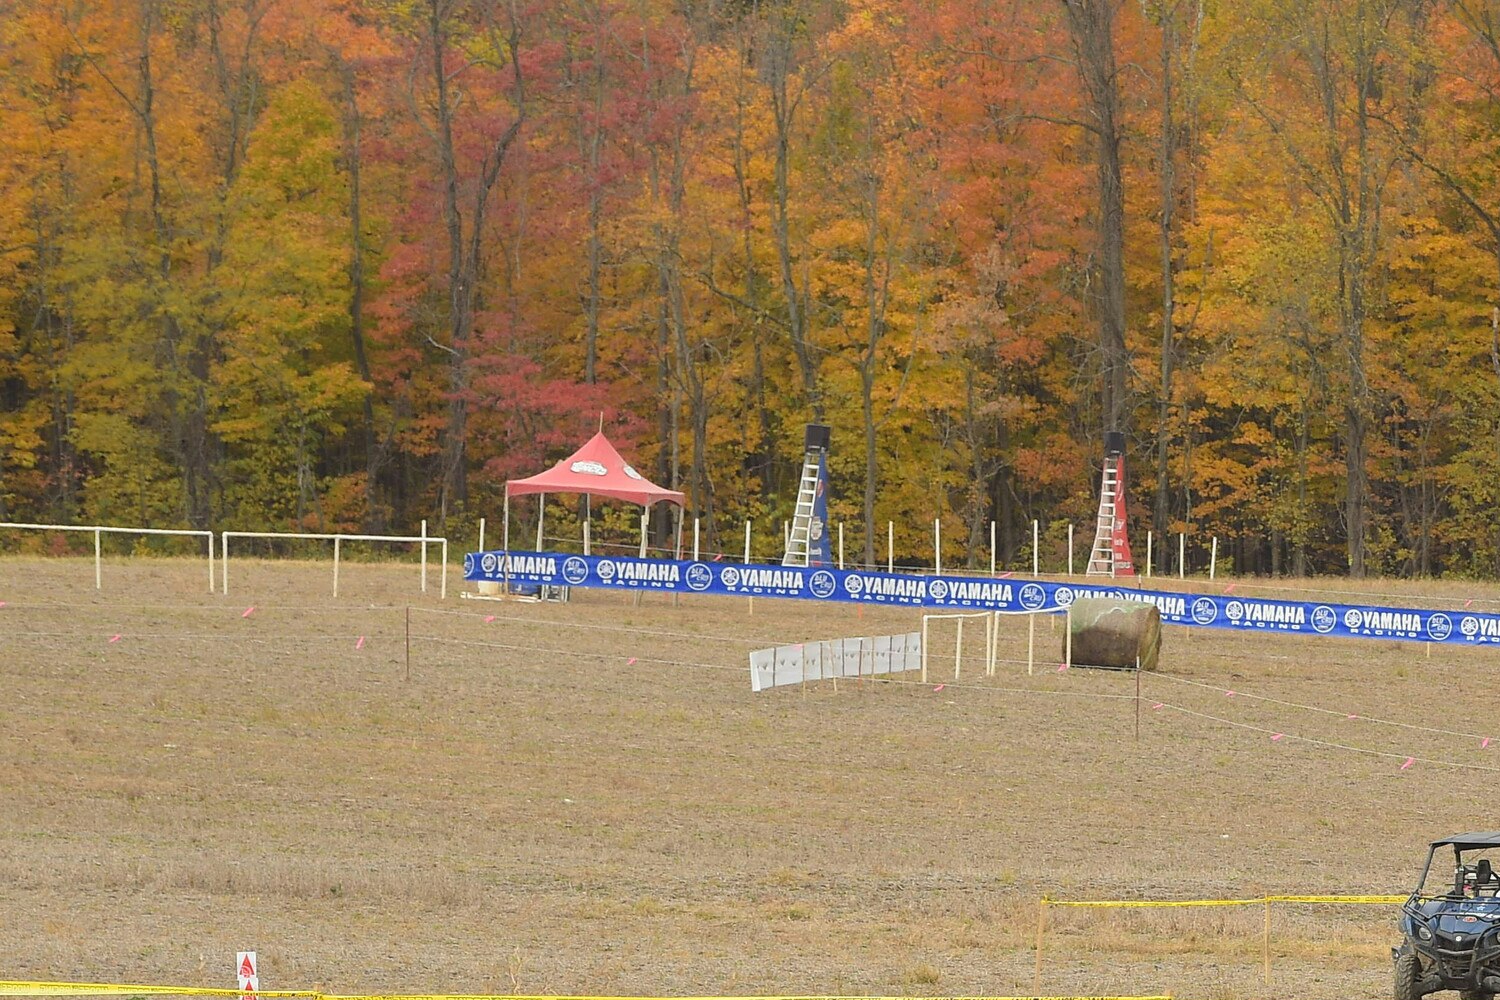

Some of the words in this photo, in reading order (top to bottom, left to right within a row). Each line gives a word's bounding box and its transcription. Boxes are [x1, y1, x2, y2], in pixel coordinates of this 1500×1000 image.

[498, 556, 556, 575] YAMAHA
[615, 562, 680, 582] YAMAHA
[603, 580, 675, 588] RACING
[740, 568, 804, 589] YAMAHA
[864, 578, 926, 598] YAMAHA
[727, 586, 799, 595] RACING
[850, 594, 922, 604] RACING
[949, 581, 1012, 602] YAMAHA
[935, 599, 1008, 608] RACING
[1244, 603, 1306, 624] YAMAHA
[1363, 611, 1421, 632] YAMAHA
[1231, 620, 1300, 630] RACING
[1350, 628, 1417, 638] RACING
